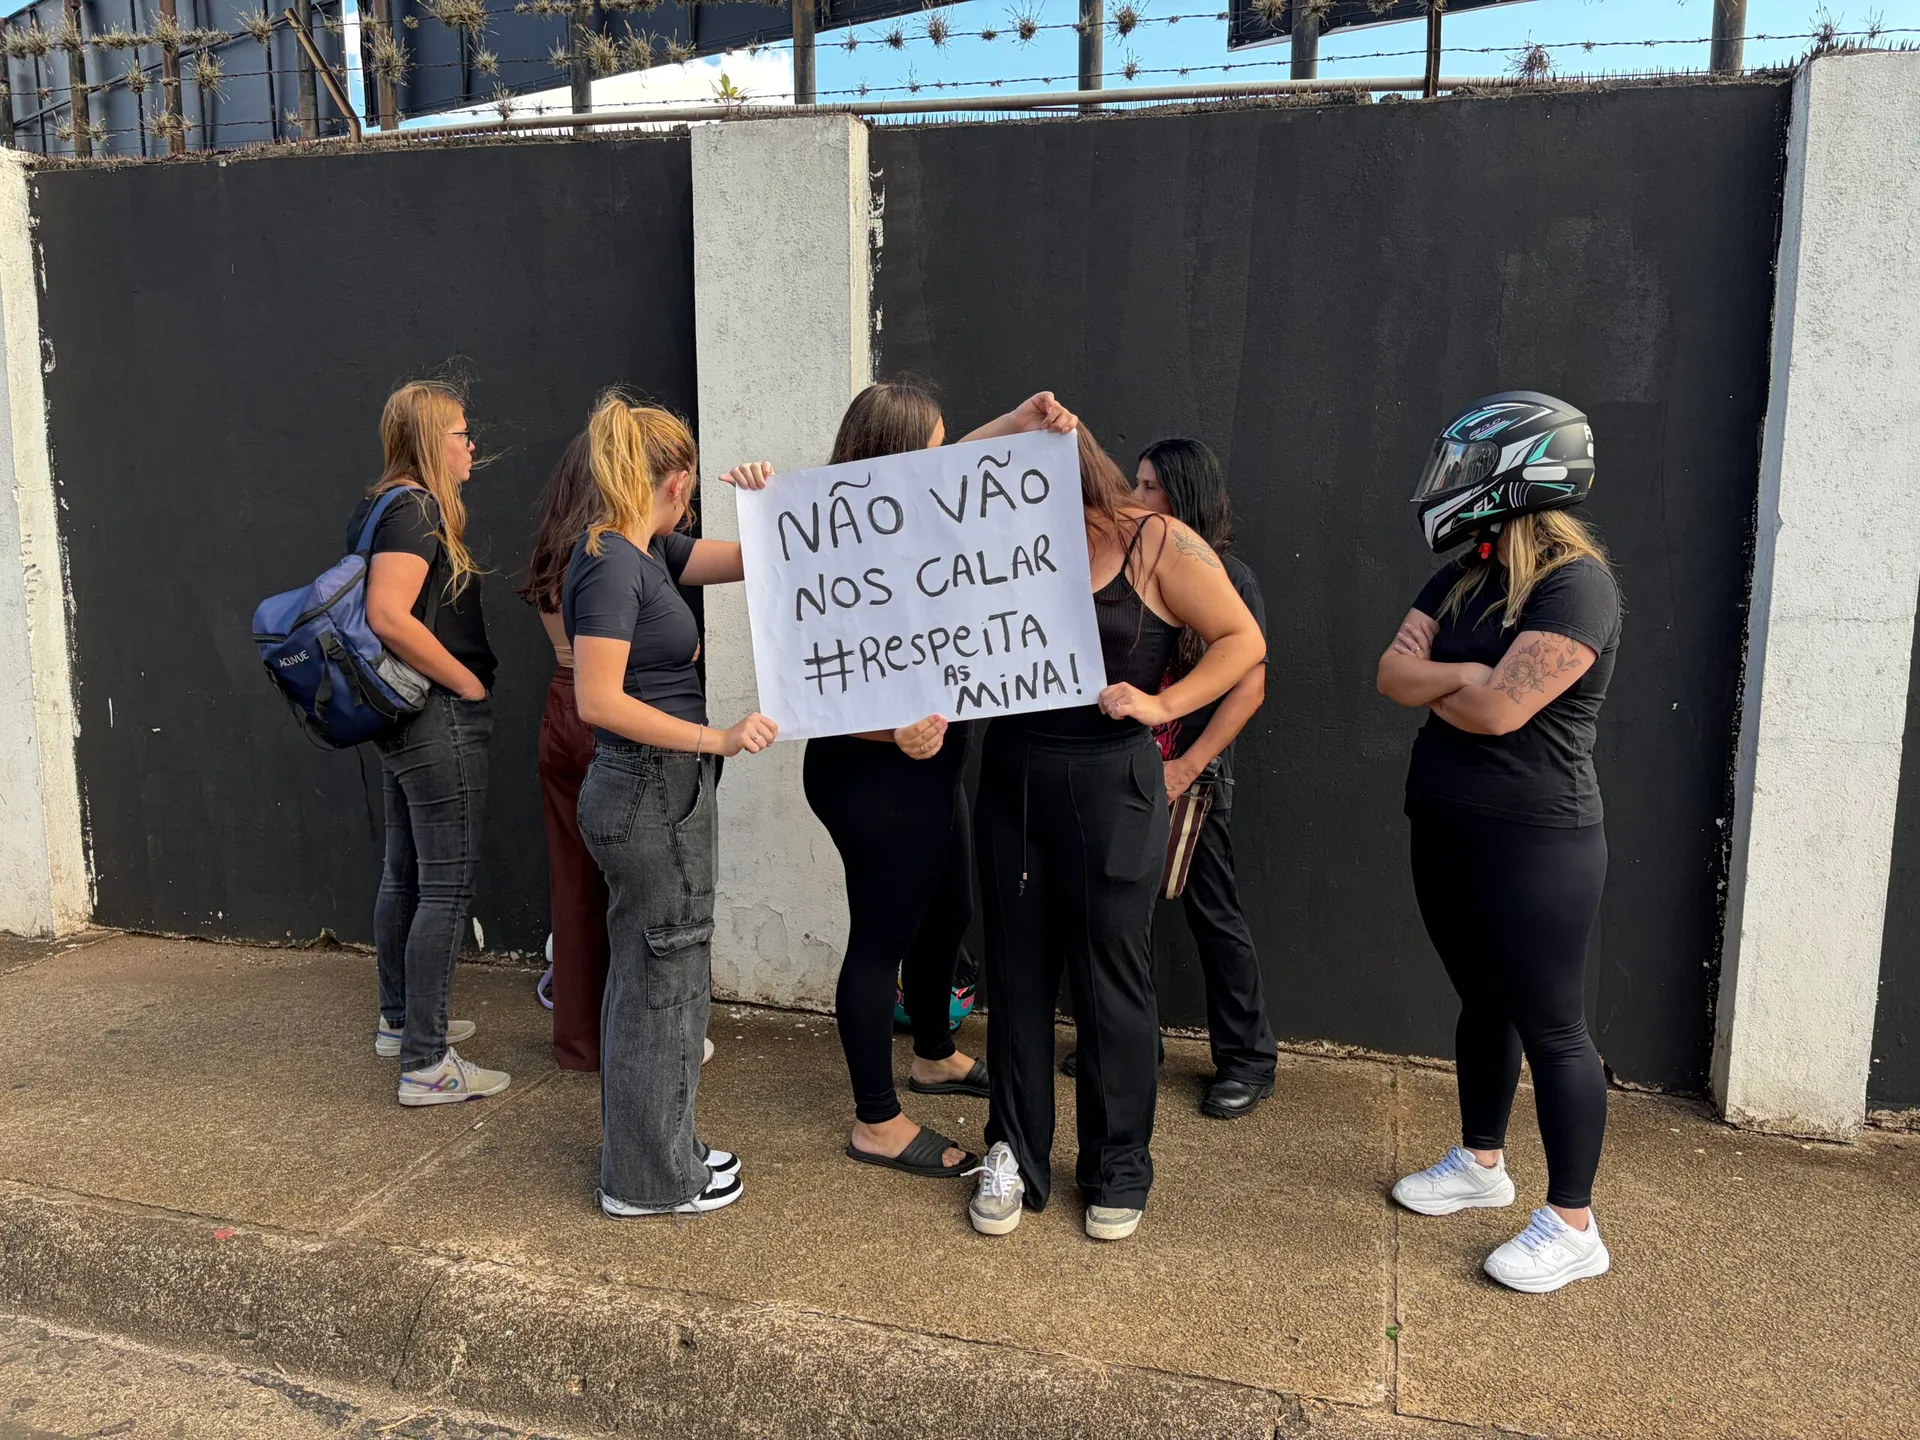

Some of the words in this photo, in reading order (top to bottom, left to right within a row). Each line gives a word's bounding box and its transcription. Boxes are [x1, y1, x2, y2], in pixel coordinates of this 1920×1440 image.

[778, 472, 904, 561] NÃO
[928, 450, 1050, 524] VÃO
[796, 567, 893, 622] NOS
[916, 534, 1057, 598] CALAR
[278, 649, 310, 668] ACUVUE
[944, 664, 971, 686] AS
